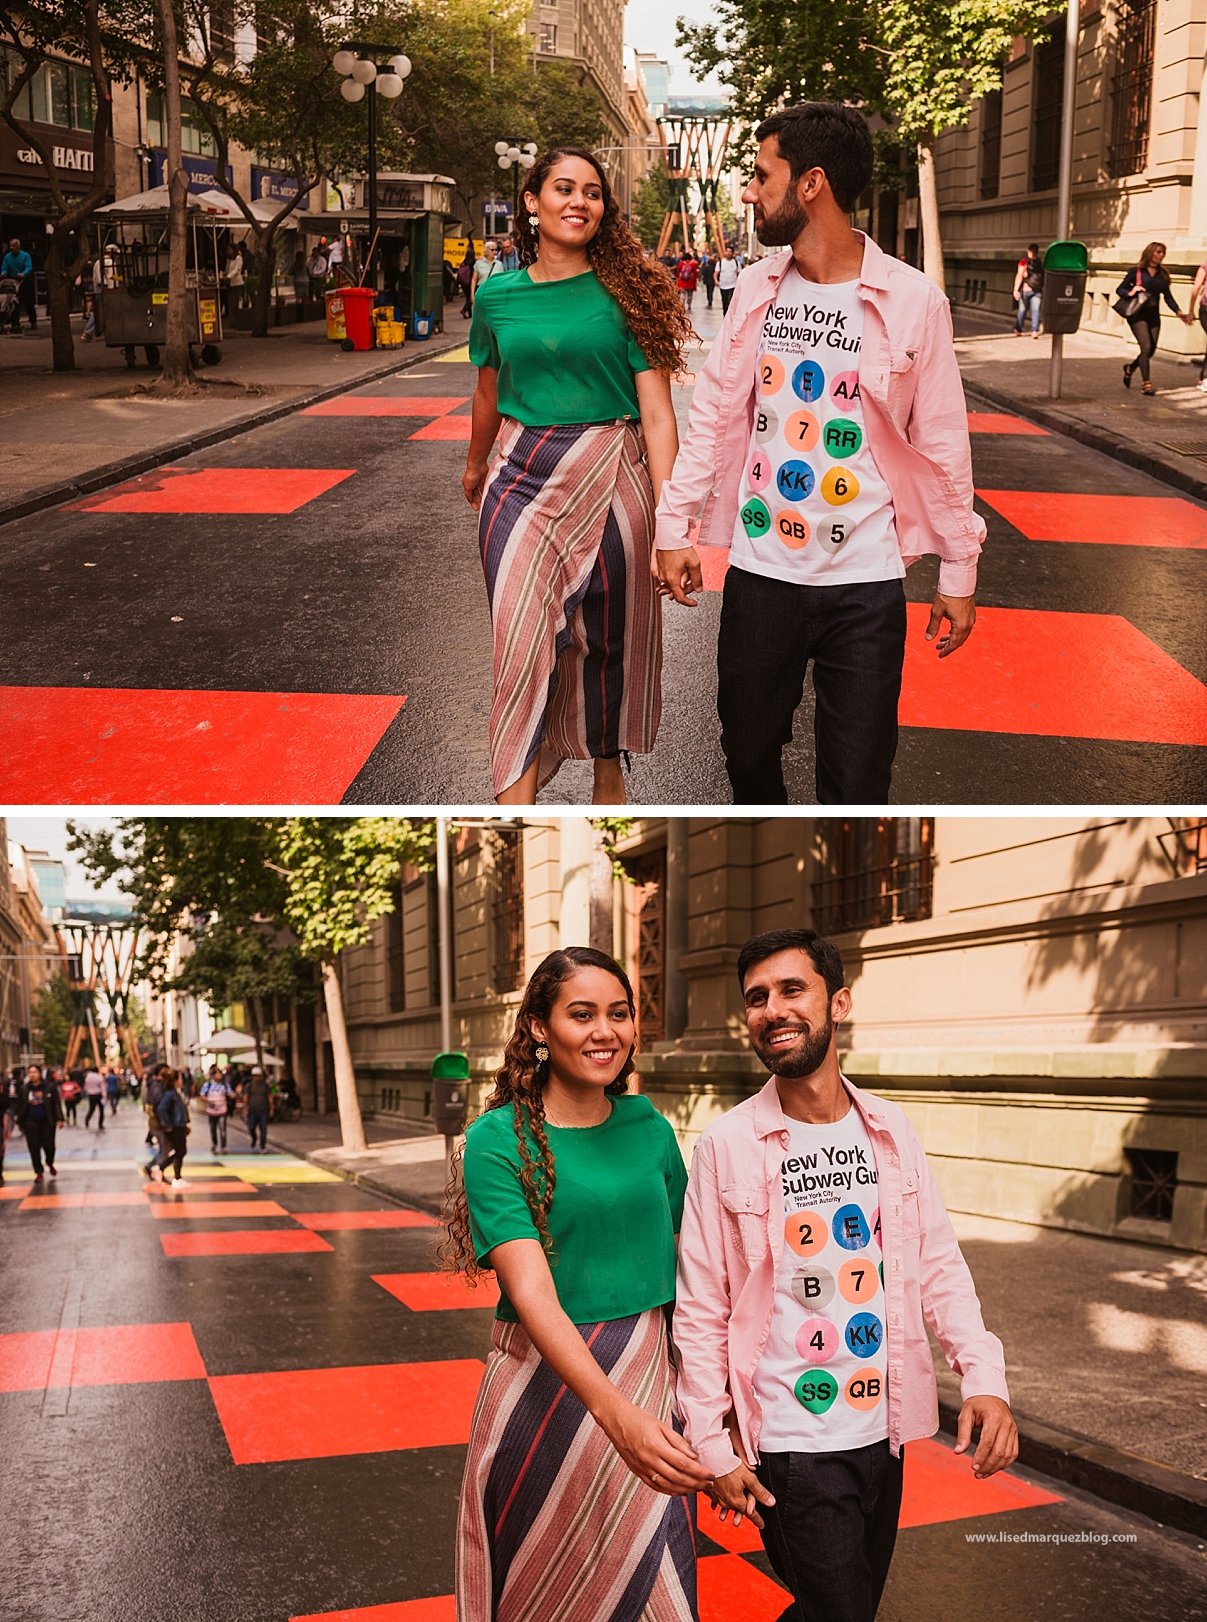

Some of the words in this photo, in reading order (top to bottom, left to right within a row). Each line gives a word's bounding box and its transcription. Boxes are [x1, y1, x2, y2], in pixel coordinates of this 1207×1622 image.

[52, 145, 93, 172] HAITI
[191, 172, 229, 187] MERC
[280, 186, 299, 197] MERC
[765, 303, 798, 320] New
[803, 304, 848, 329] York
[763, 322, 824, 347] Subway
[826, 330, 861, 353] Gui
[762, 366, 773, 385] 2
[802, 371, 814, 392] E
[833, 381, 862, 401] AA
[756, 413, 768, 432] B
[799, 421, 809, 440] 7
[826, 428, 857, 448] RR
[752, 462, 761, 480] 4
[780, 469, 809, 492] KK
[835, 477, 847, 496] 6
[742, 508, 765, 528] SS
[779, 519, 806, 540] QB
[830, 524, 845, 544] 5
[821, 1145, 867, 1165] York
[782, 1171, 852, 1196] Subway
[808, 1191, 822, 1199] York
[796, 1200, 818, 1208] Transit
[819, 1196, 841, 1204] Autority
[799, 1224, 813, 1245] 2
[843, 1216, 861, 1238] E
[804, 1277, 821, 1298] B
[850, 1270, 865, 1292] 7
[810, 1330, 825, 1351] 4
[849, 1323, 879, 1346] KK
[801, 1382, 831, 1401] SS
[849, 1378, 881, 1398] QB
